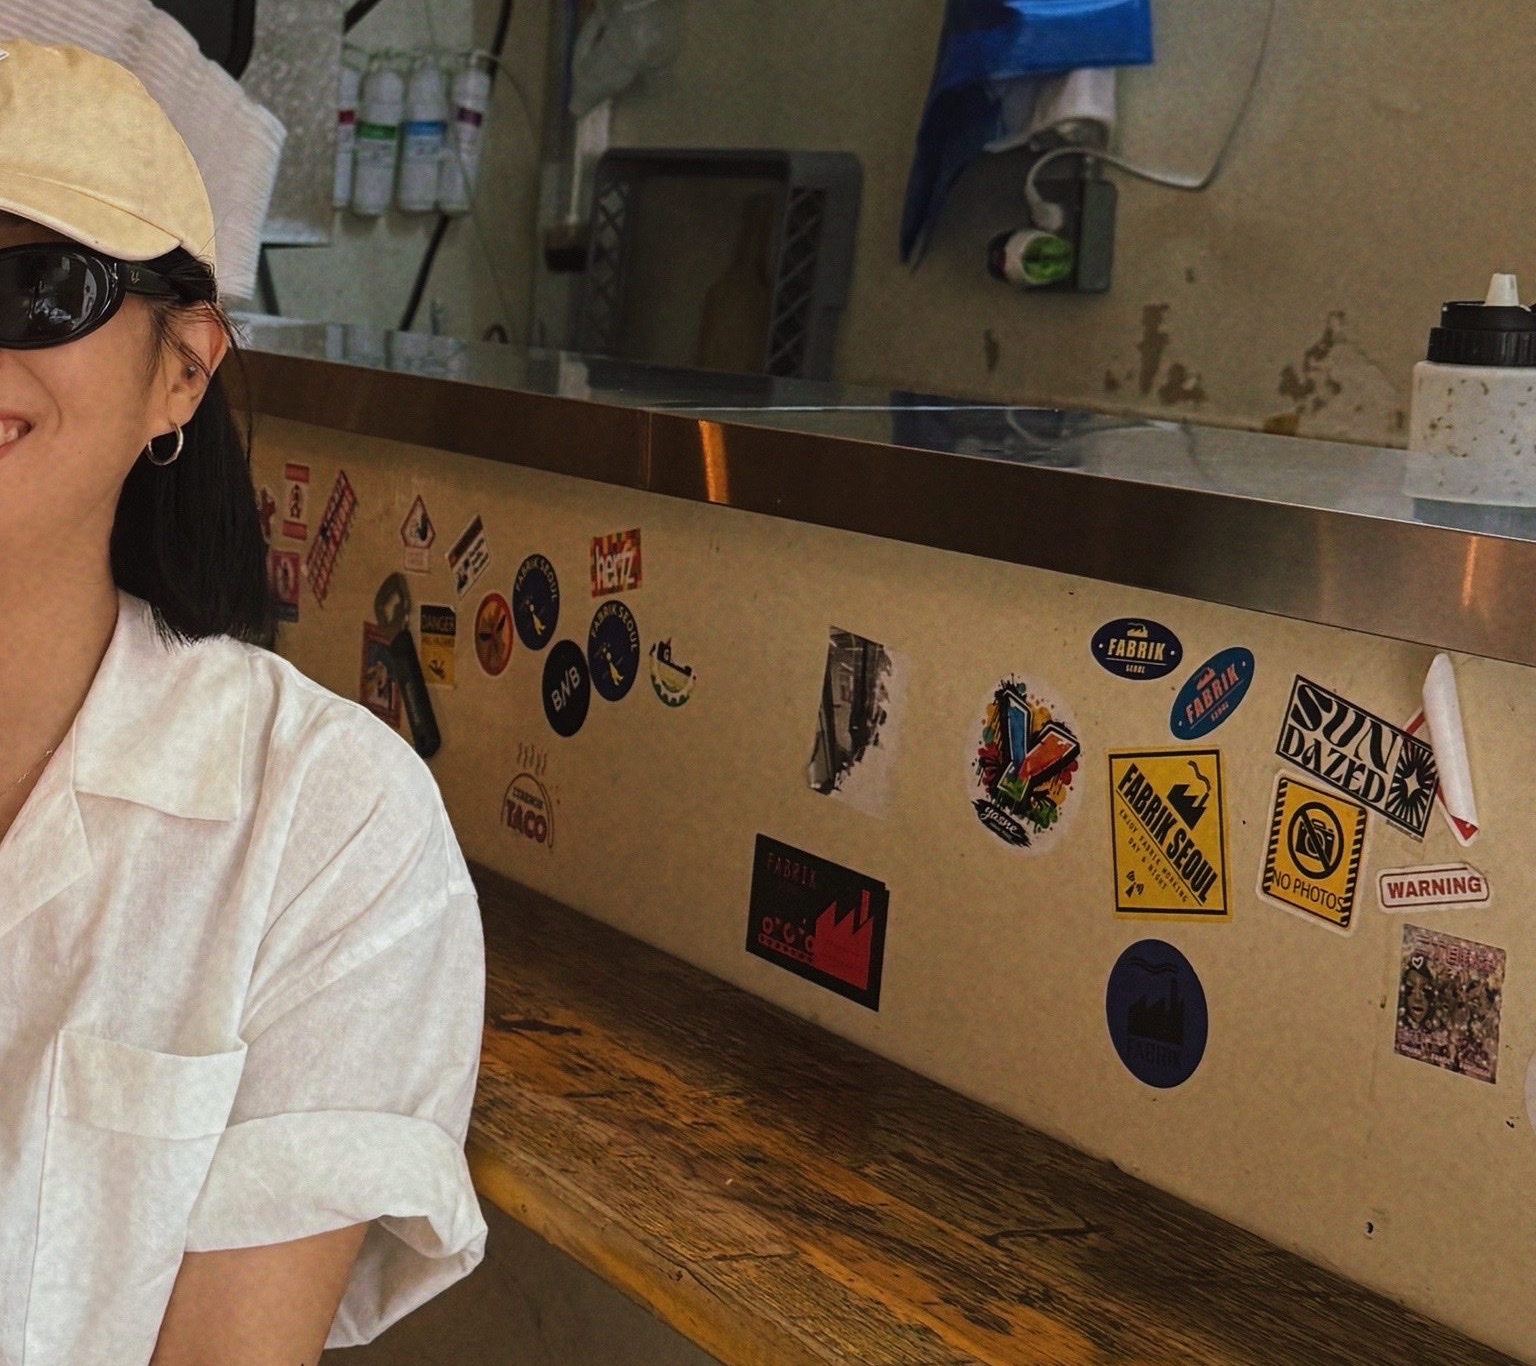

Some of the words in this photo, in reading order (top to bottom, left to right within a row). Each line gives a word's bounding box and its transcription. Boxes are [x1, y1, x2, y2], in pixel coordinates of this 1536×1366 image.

[617, 606, 639, 653] SEOUL
[1107, 638, 1166, 661] FABRIK
[1184, 662, 1240, 725] FABRIK
[1290, 683, 1401, 775] SUN
[1280, 723, 1386, 804] DAZED
[506, 798, 547, 843] TACO
[1117, 762, 1178, 847] FABRIK
[1165, 827, 1218, 904] SEOUL
[1272, 868, 1292, 891] NO
[1293, 877, 1346, 913] PHOTOS
[1387, 876, 1483, 900] WARNING
